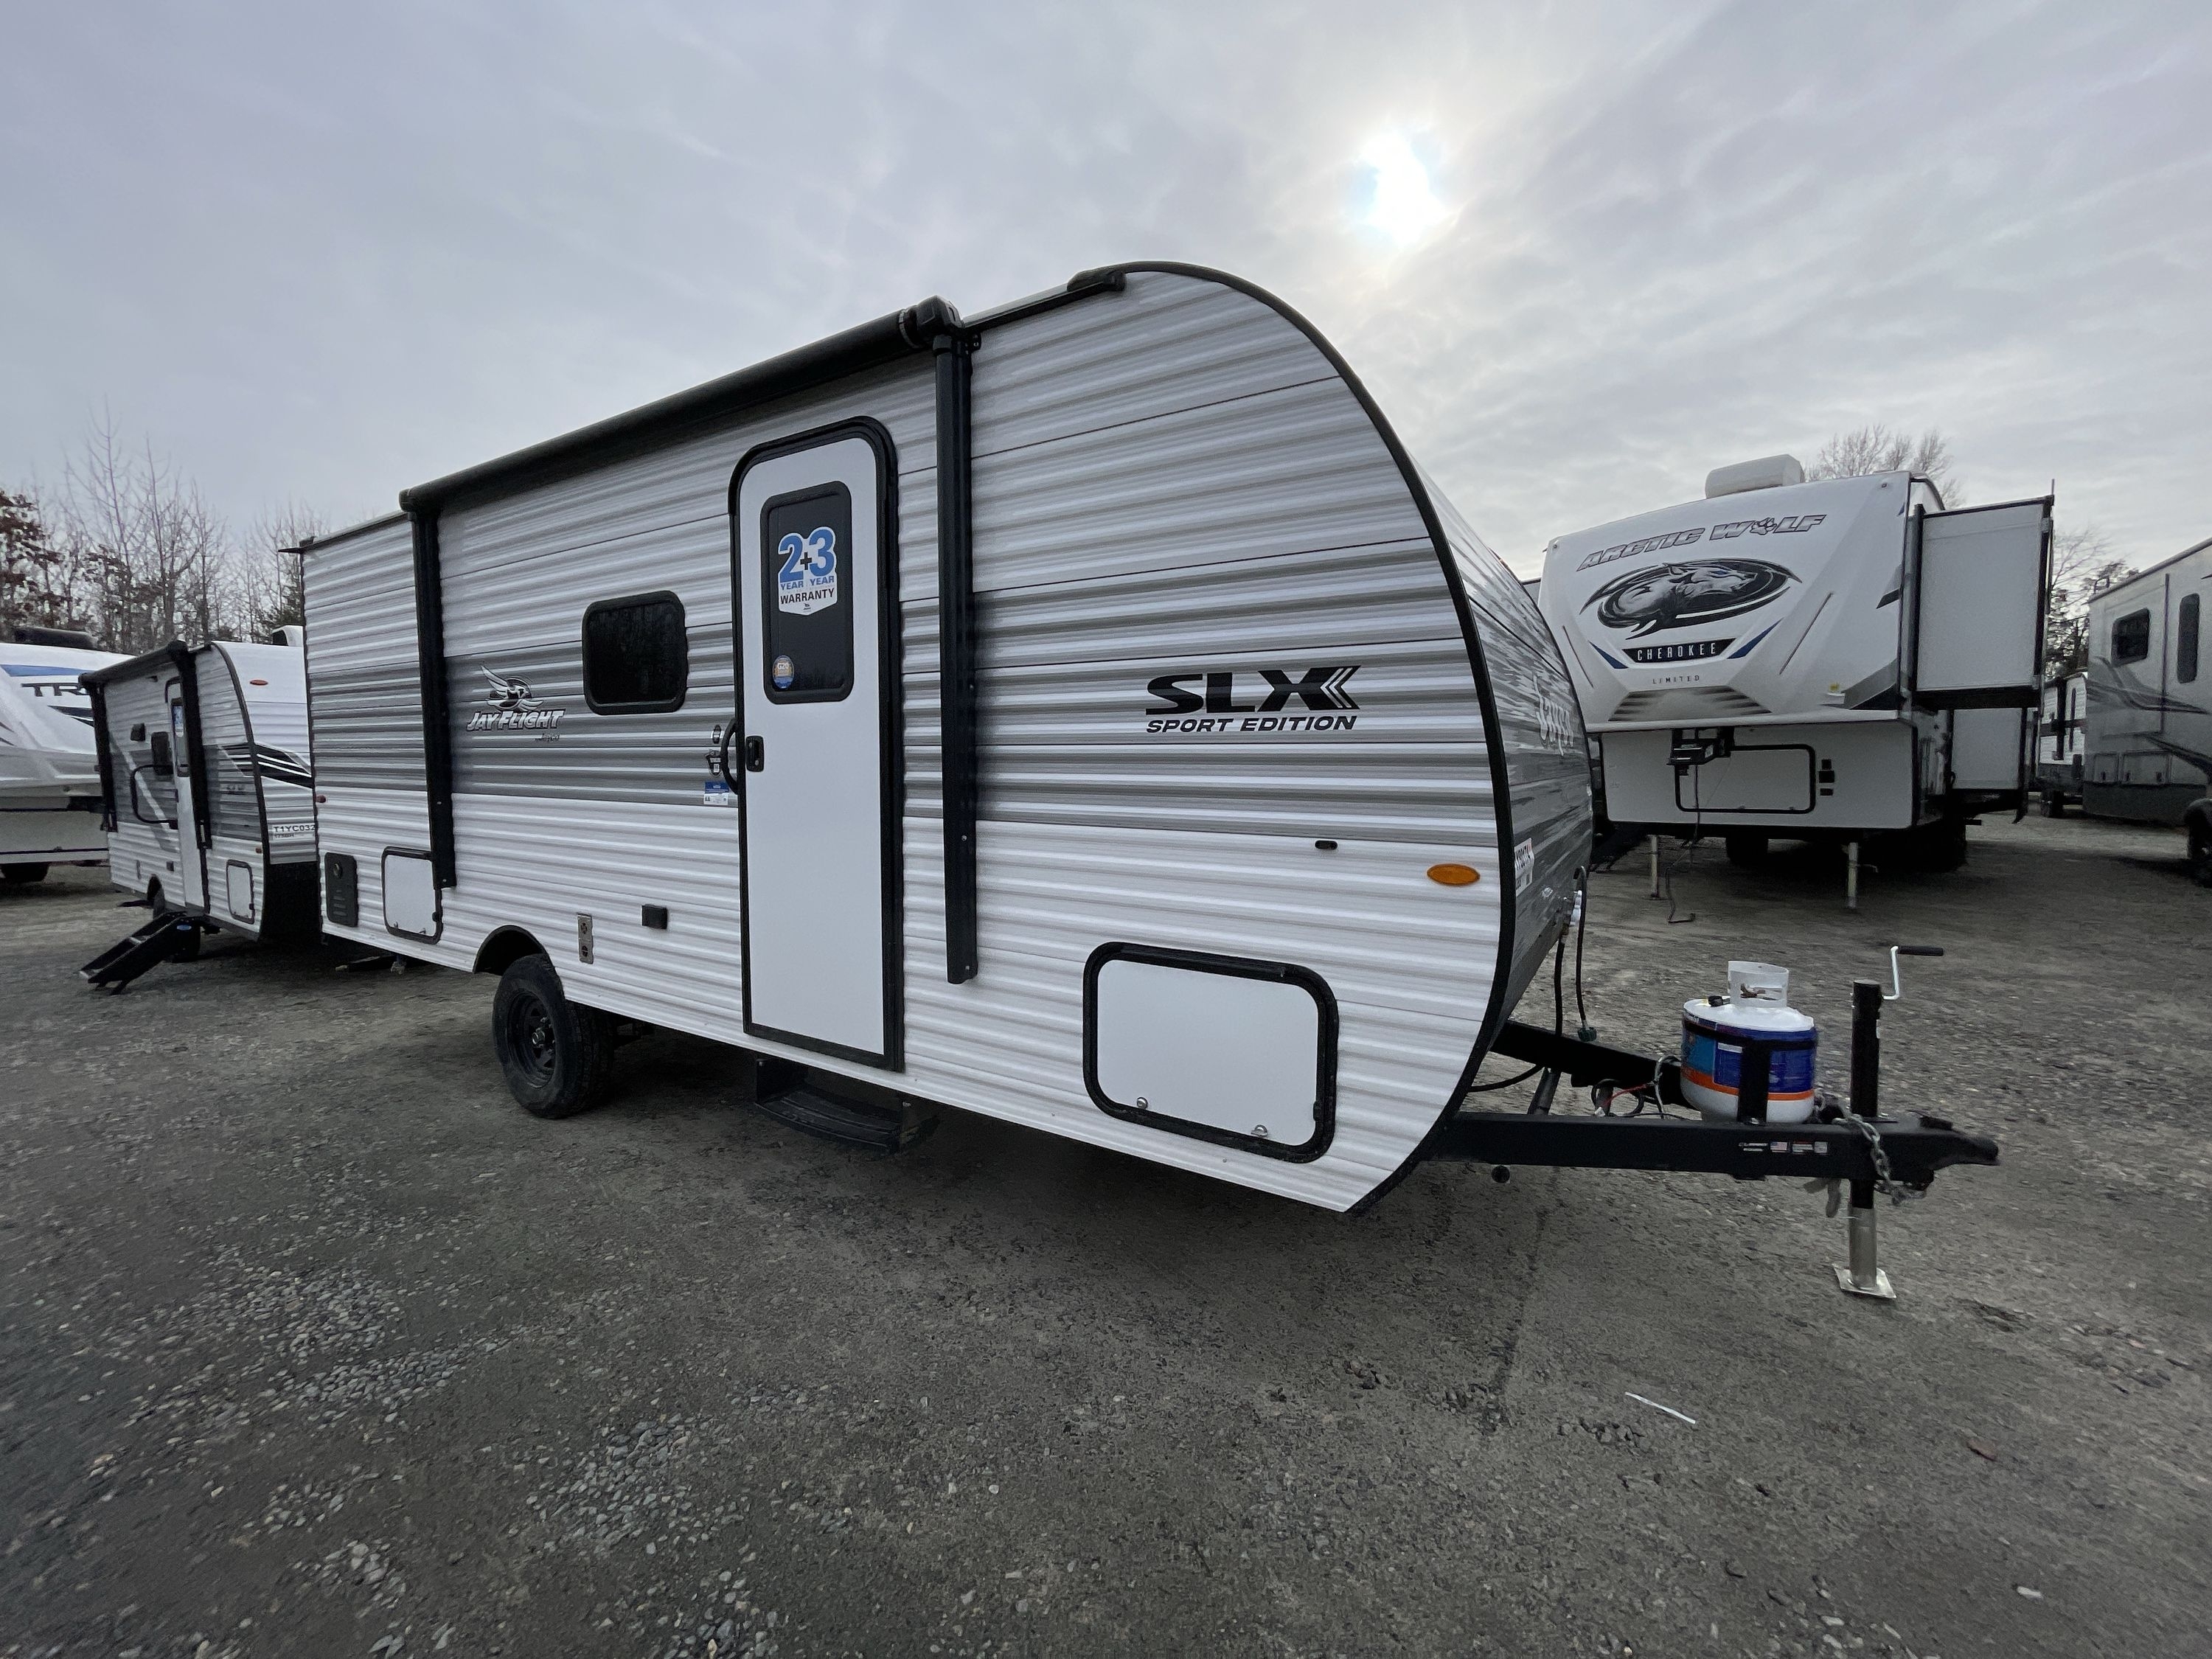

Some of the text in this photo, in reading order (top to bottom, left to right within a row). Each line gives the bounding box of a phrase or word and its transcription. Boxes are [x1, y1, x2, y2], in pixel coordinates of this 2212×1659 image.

[1576, 527, 1705, 571] ARCTIC
[780, 575, 835, 591] YEAR YEAR
[780, 588, 835, 605] WARRANTY
[1637, 642, 1716, 661] CHEROKEE
[1652, 675, 1700, 684] LIMITED
[1145, 665, 1361, 715] SLX
[466, 709, 566, 731] JAY FLIGHT
[1147, 715, 1357, 733] SPORT EDITION
